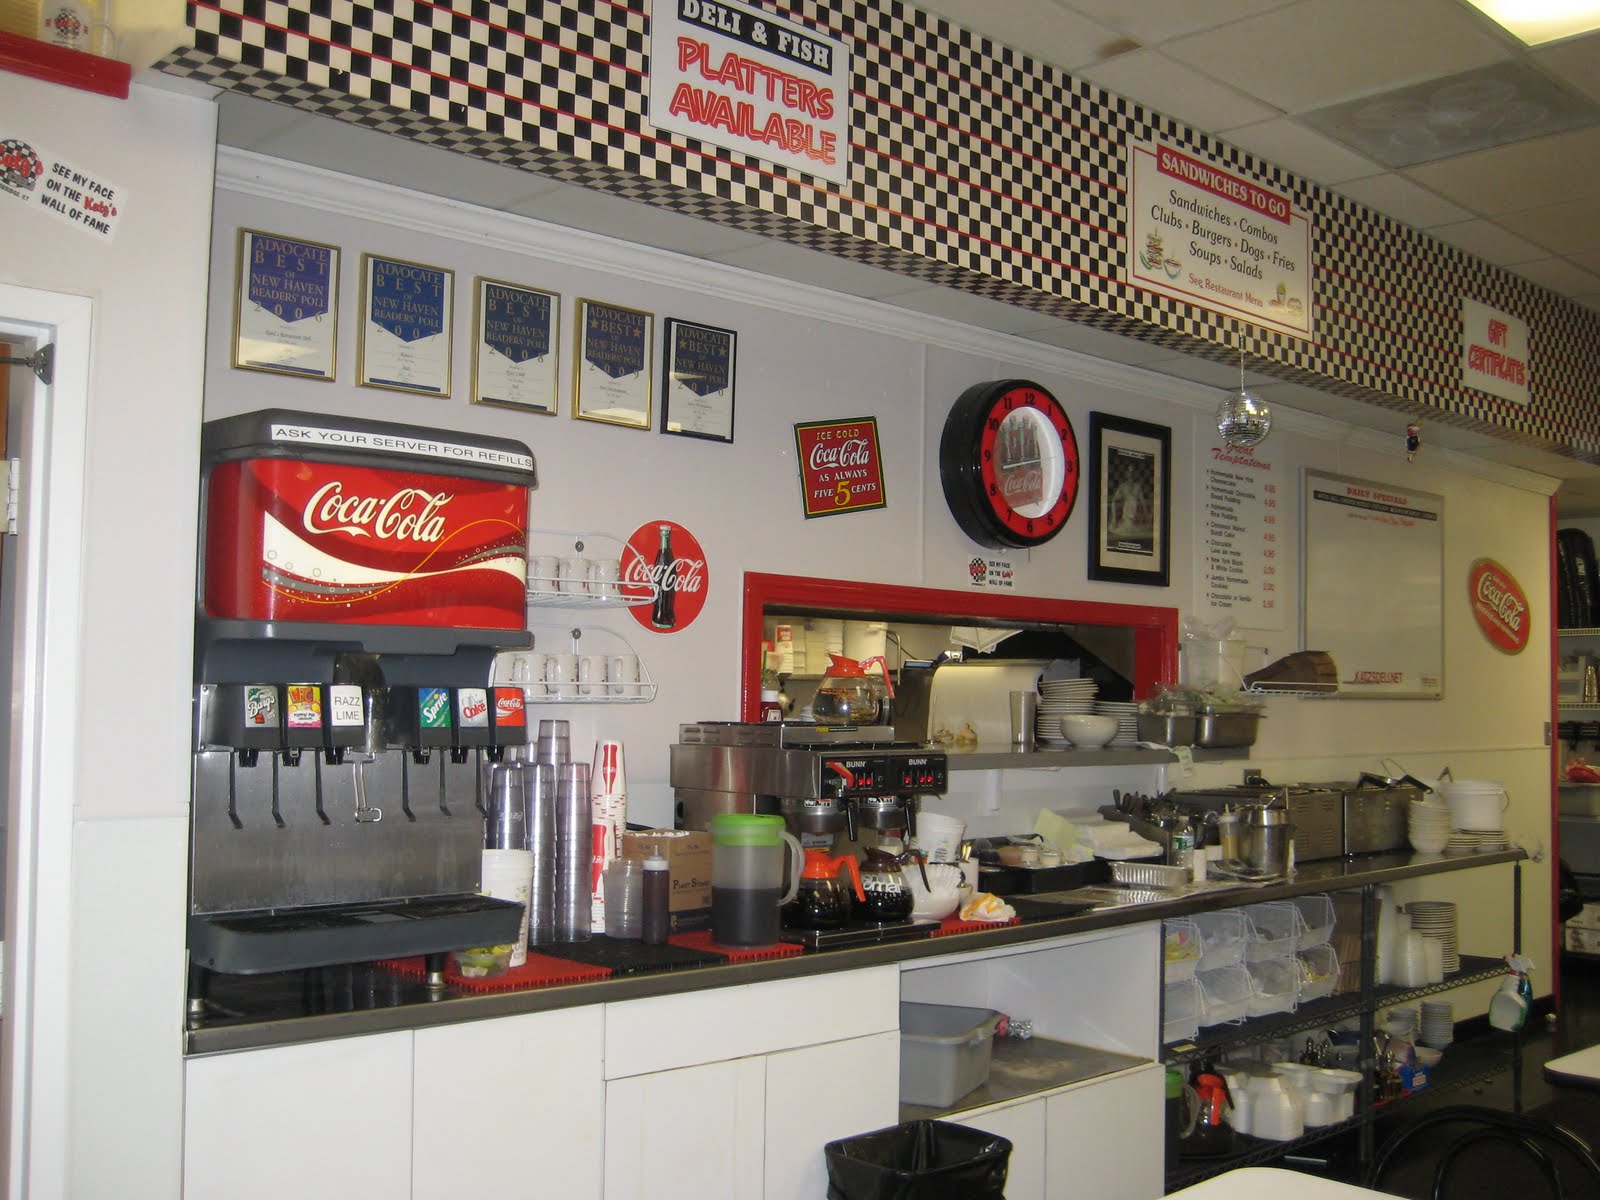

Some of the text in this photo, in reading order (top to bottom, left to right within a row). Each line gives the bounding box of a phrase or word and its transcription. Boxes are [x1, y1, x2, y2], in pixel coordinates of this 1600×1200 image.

[682, 0, 829, 69] DELI & FISH
[677, 37, 834, 120] PLATTERS
[669, 83, 837, 166] AVAILABLE
[46, 179, 62, 194] ON
[64, 185, 83, 203] THE
[52, 163, 115, 200] SEE MY FACE
[1162, 152, 1286, 218] SANDWICHES TO GO
[41, 194, 111, 235] WALL OF FAME
[1169, 189, 1278, 245] Sandwiches Combos
[1151, 204, 1295, 272] Clubs Burgers Dogs Fries
[255, 238, 327, 262] ADVOCATE
[1189, 241, 1263, 280] Soups Salads
[285, 271, 296, 280] OF
[377, 263, 440, 284] ADVOCATE
[252, 273, 324, 296] NEW HAVEN
[1188, 272, 1264, 308] See Restaurant Menu
[301, 296, 324, 308] POLL
[374, 295, 439, 316] NEW HAVEN
[403, 293, 413, 301] OF
[488, 287, 549, 308] ADVOCATE
[590, 306, 644, 326] ADVOCATE
[487, 320, 545, 339] NEW HAVEN
[601, 320, 631, 337] BEST
[678, 327, 727, 345] ADVOCATE
[587, 337, 640, 356] NEW HAVEN
[689, 340, 718, 356] BEST
[1004, 398, 1012, 410] 11
[1025, 393, 1035, 405] 12
[1047, 404, 1051, 414] 1
[986, 418, 999, 430] 10
[816, 429, 860, 441] ICE COLD
[1061, 428, 1067, 441] 2
[276, 428, 532, 468] ASK YOUR SERVER FOR REFILLS
[809, 438, 869, 471] Coca-Cola
[984, 450, 991, 461] 9
[1067, 462, 1073, 473] 3
[1211, 447, 1271, 470] Temptations
[819, 469, 868, 482] AS ALWAYS
[1004, 470, 1041, 496] Coca-Cola
[814, 480, 876, 506] FIVE 5 CENTS
[990, 484, 996, 496] 8
[1062, 493, 1068, 504] 4
[1347, 487, 1370, 498] DAILY
[302, 481, 455, 544] Coca-Cola
[1007, 510, 1013, 521] 7
[1026, 521, 1033, 533] 6
[1047, 518, 1053, 527] 5
[624, 555, 703, 593] Coca-Cola
[1477, 571, 1525, 632] Coca-Cola
[247, 696, 276, 719] Barq's
[334, 696, 360, 707] RAZZ
[423, 692, 448, 723] Sprite
[463, 702, 486, 719] Coke
[498, 698, 522, 709] Coca-Cola
[336, 710, 360, 720] LIME
